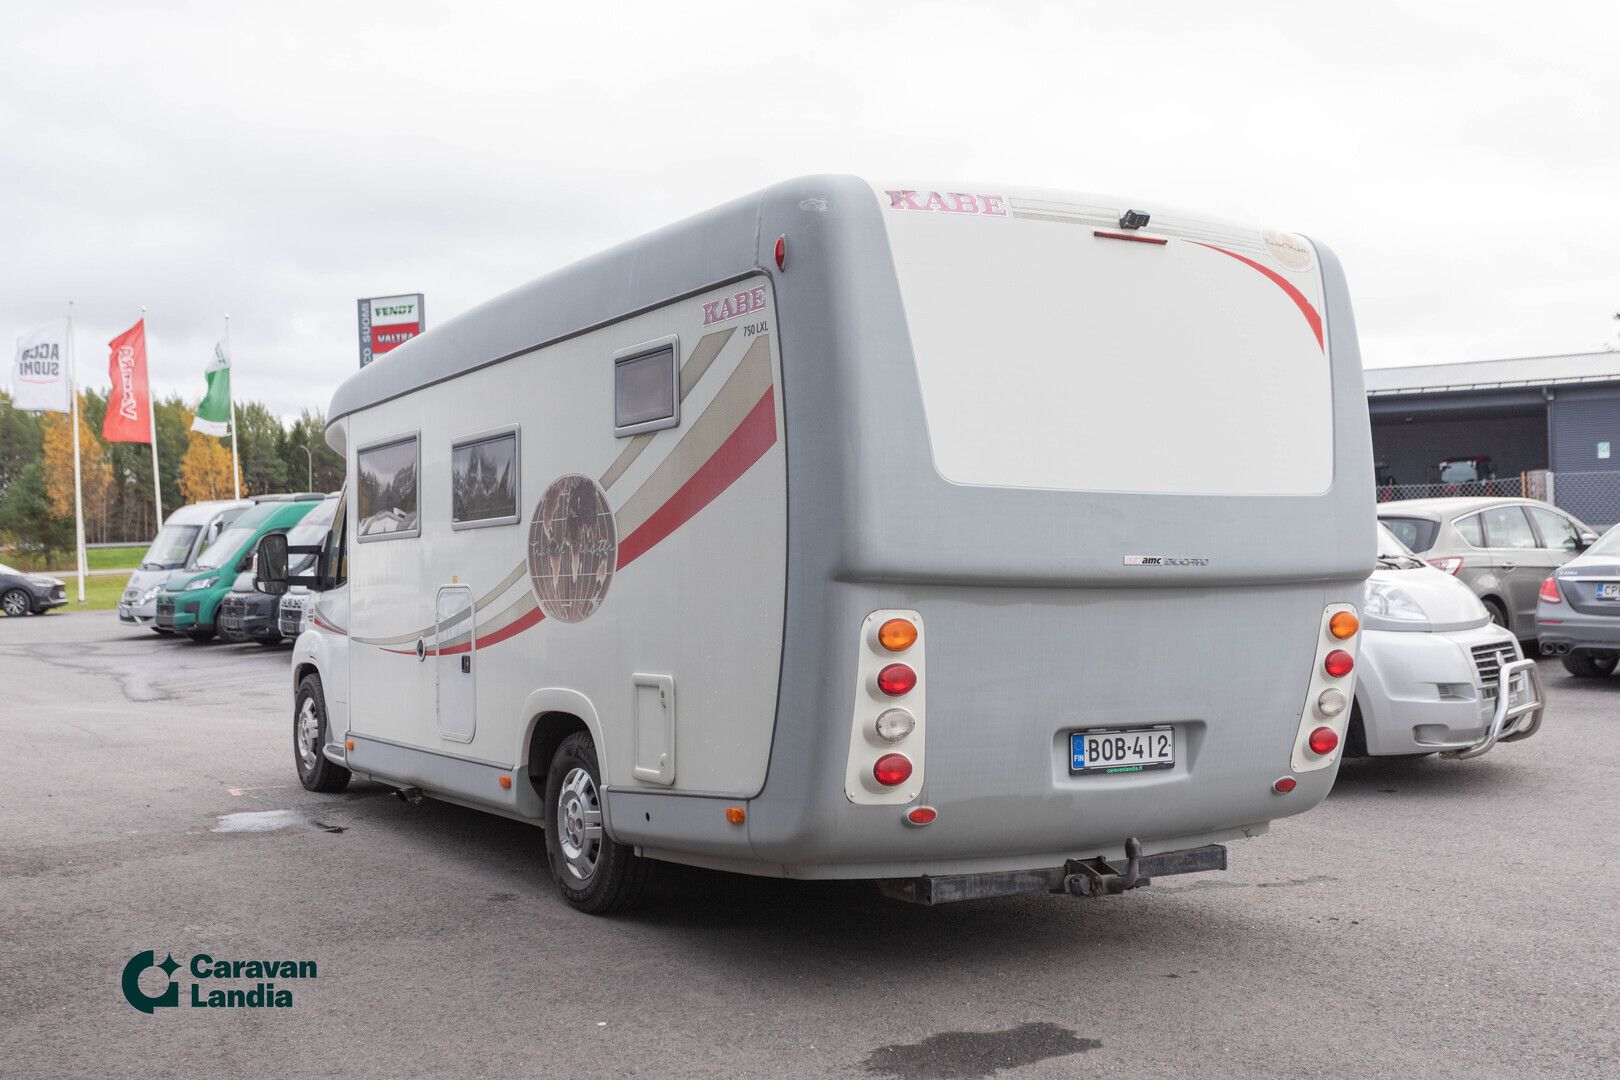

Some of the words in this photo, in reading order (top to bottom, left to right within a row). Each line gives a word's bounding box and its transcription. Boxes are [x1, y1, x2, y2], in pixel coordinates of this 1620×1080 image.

[885, 189, 1008, 217] KABE
[375, 304, 415, 316] FENDT
[702, 284, 767, 327] KABE
[361, 302, 371, 343] SUOMI
[743, 324, 756, 337] 750
[756, 320, 769, 334] LXL
[1141, 556, 1162, 565] amc
[1073, 754, 1085, 762] FIN
[1088, 734, 1170, 762] BOB-412
